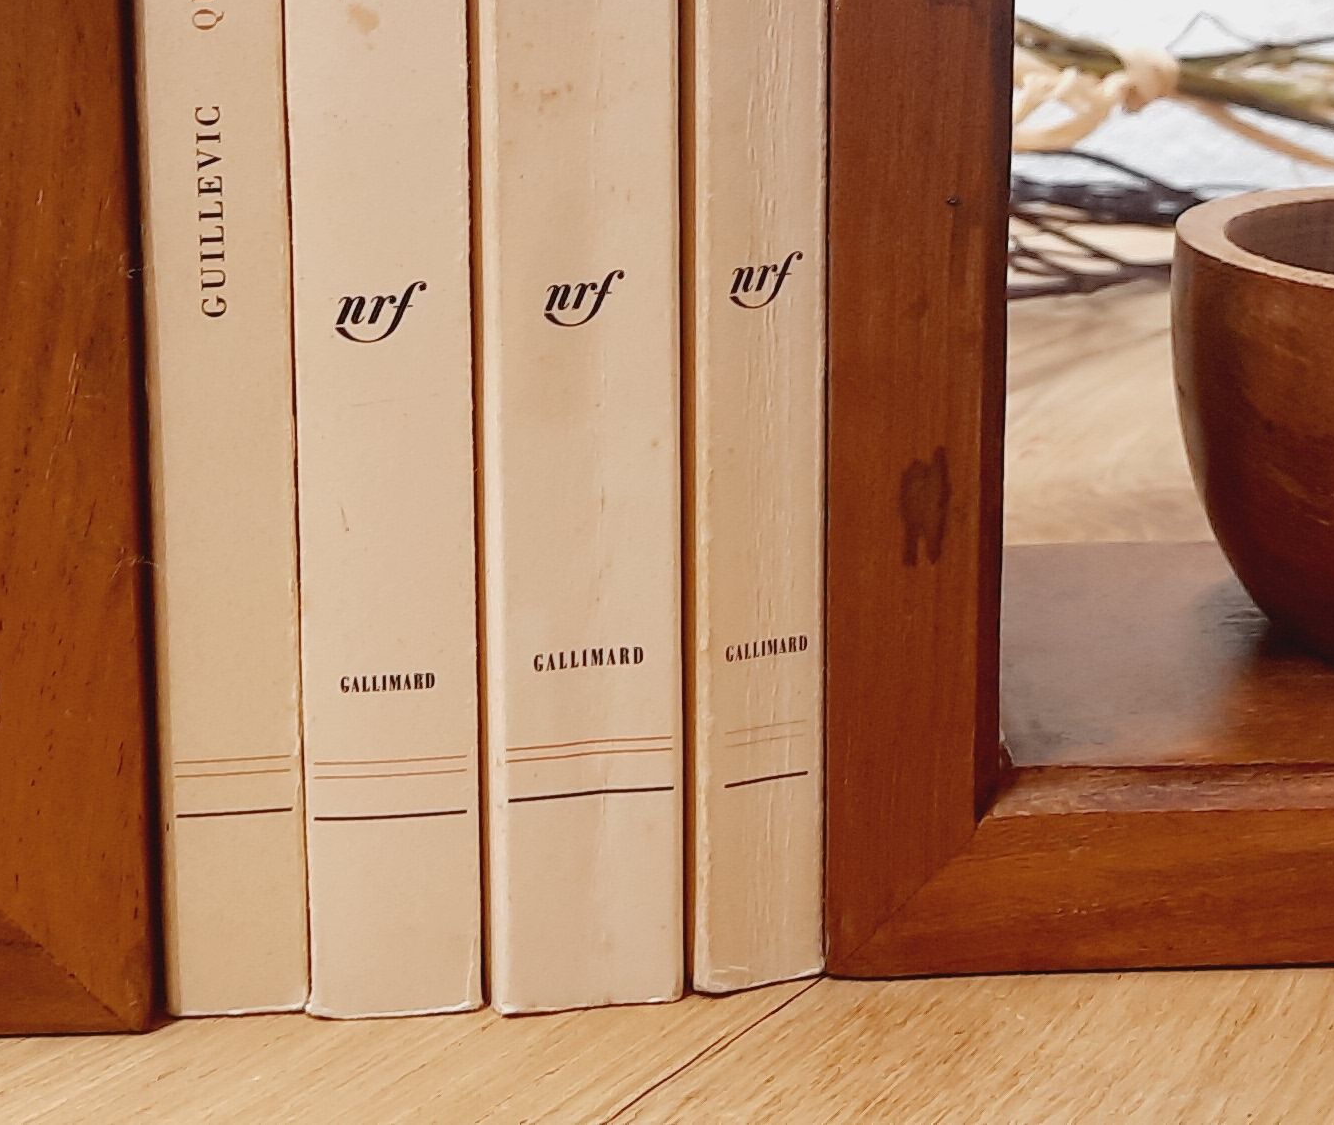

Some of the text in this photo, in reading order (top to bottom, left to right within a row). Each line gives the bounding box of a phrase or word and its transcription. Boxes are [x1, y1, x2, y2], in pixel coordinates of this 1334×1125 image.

[194, 106, 228, 318] GUILLEVIC
[543, 269, 625, 328] nrf
[729, 250, 804, 310] nrf
[334, 280, 428, 344] nrf
[533, 646, 644, 673] GALLIMARD
[725, 634, 808, 663] GALLIMARD
[340, 672, 436, 694] GALLIMARD
